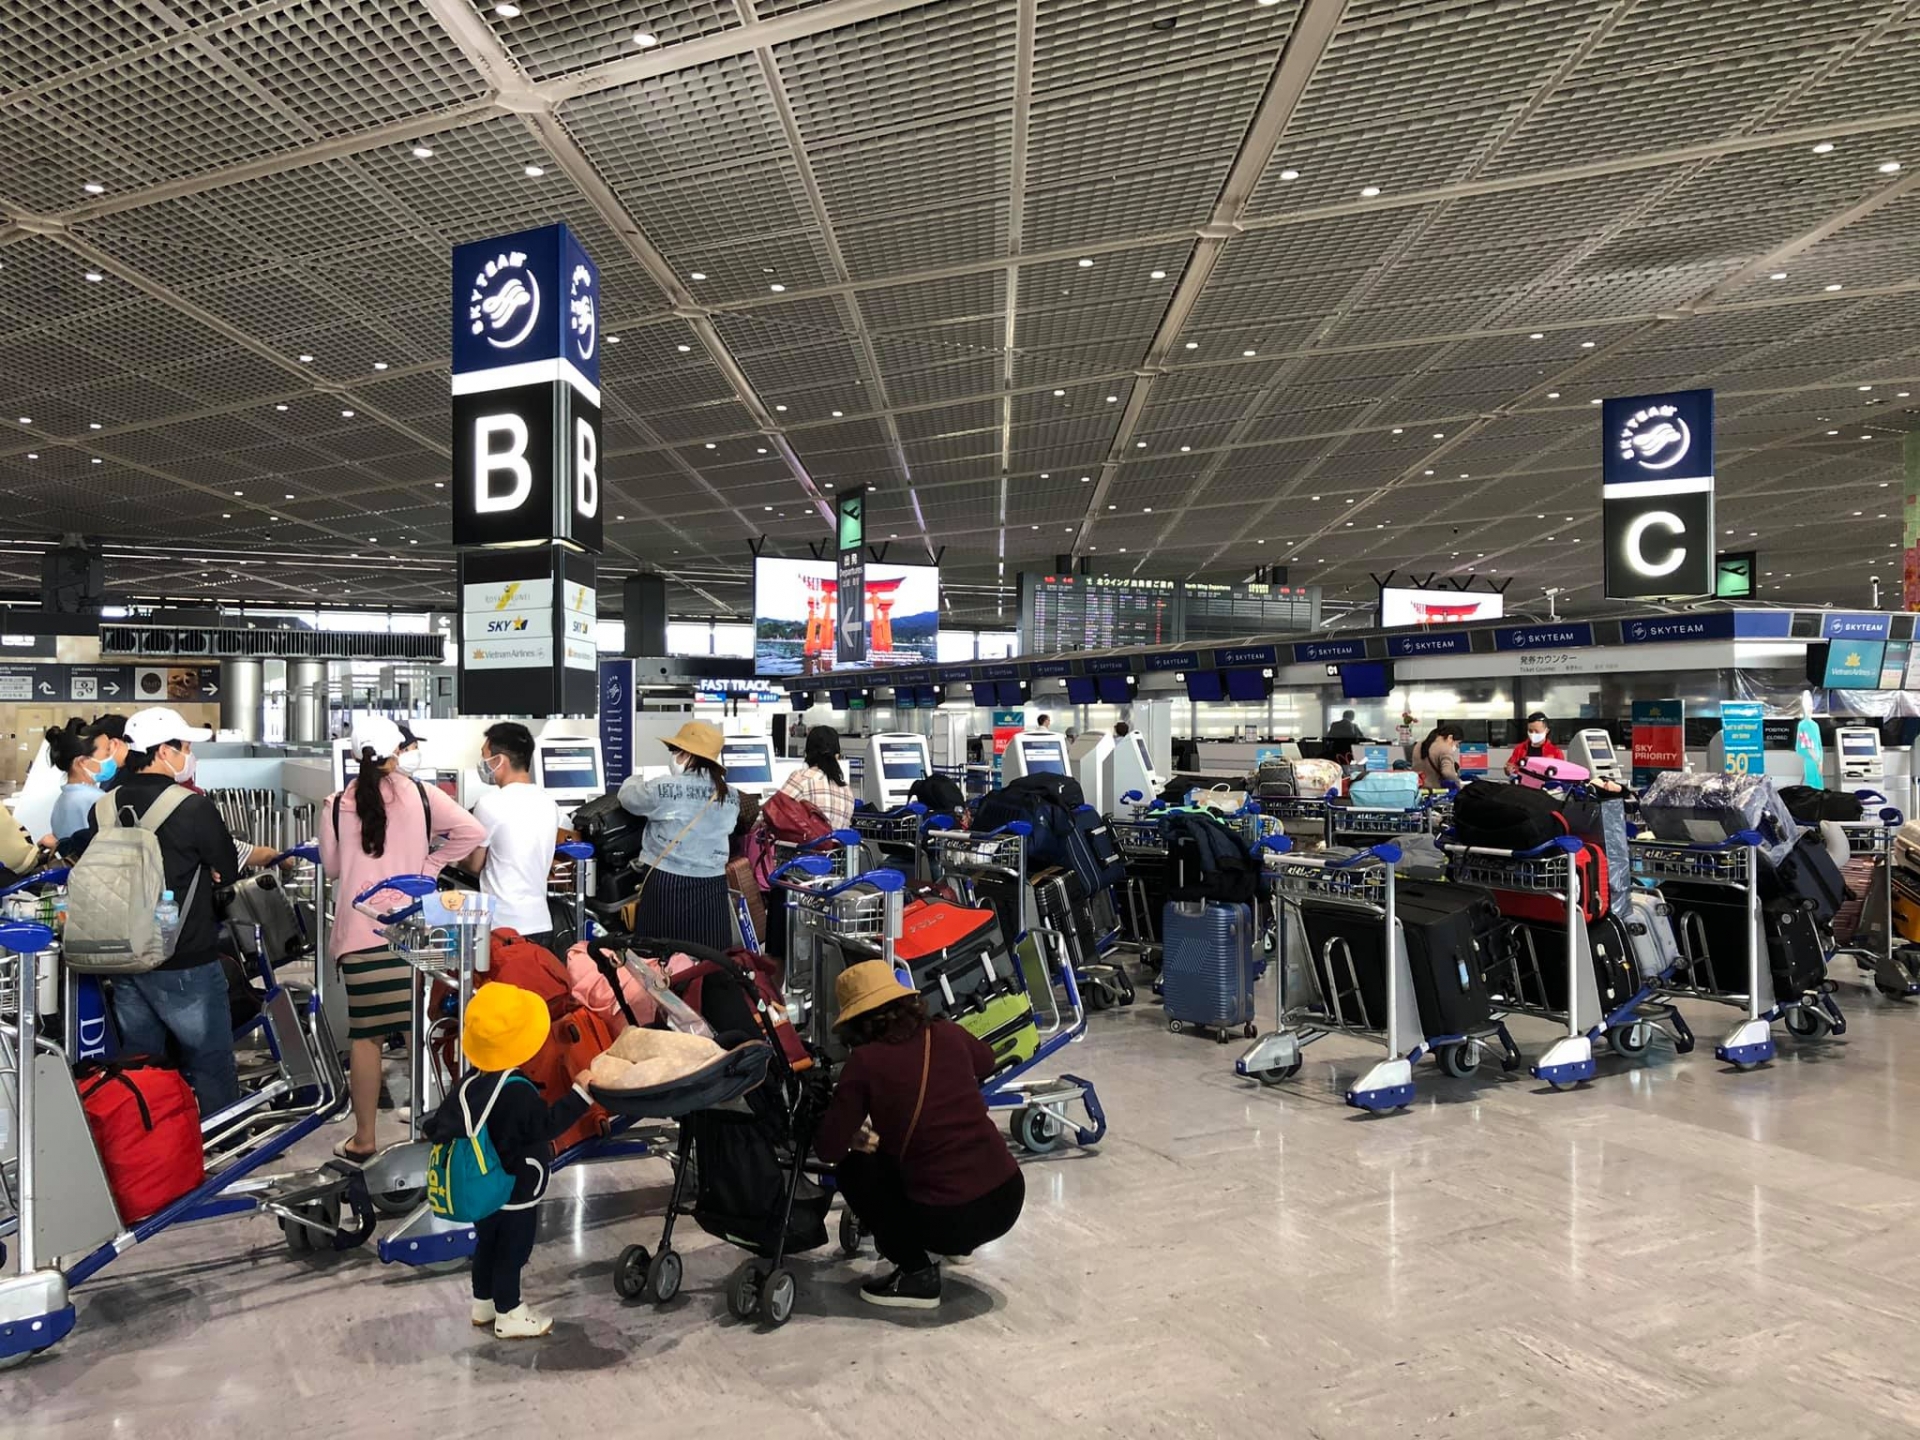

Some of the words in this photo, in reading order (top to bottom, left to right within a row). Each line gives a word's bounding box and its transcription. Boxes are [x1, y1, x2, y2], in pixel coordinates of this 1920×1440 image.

[475, 413, 532, 513] B
[577, 416, 598, 518] B
[1626, 511, 1686, 577] C
[487, 620, 512, 632] SKY
[1650, 624, 1704, 636] SKYTEAM
[1845, 623, 1883, 631] SKYTEAM
[1528, 632, 1574, 643] SKYTEAM
[1415, 640, 1454, 650] SKYTEAM
[1318, 647, 1352, 655] SKYTEAM
[1235, 653, 1265, 661] SKYTEAM
[701, 679, 729, 691] FAST
[731, 679, 771, 691] TRACK
[1634, 744, 1653, 752] SKY
[1634, 752, 1677, 760] PRIORITY
[1725, 753, 1748, 775] 50
